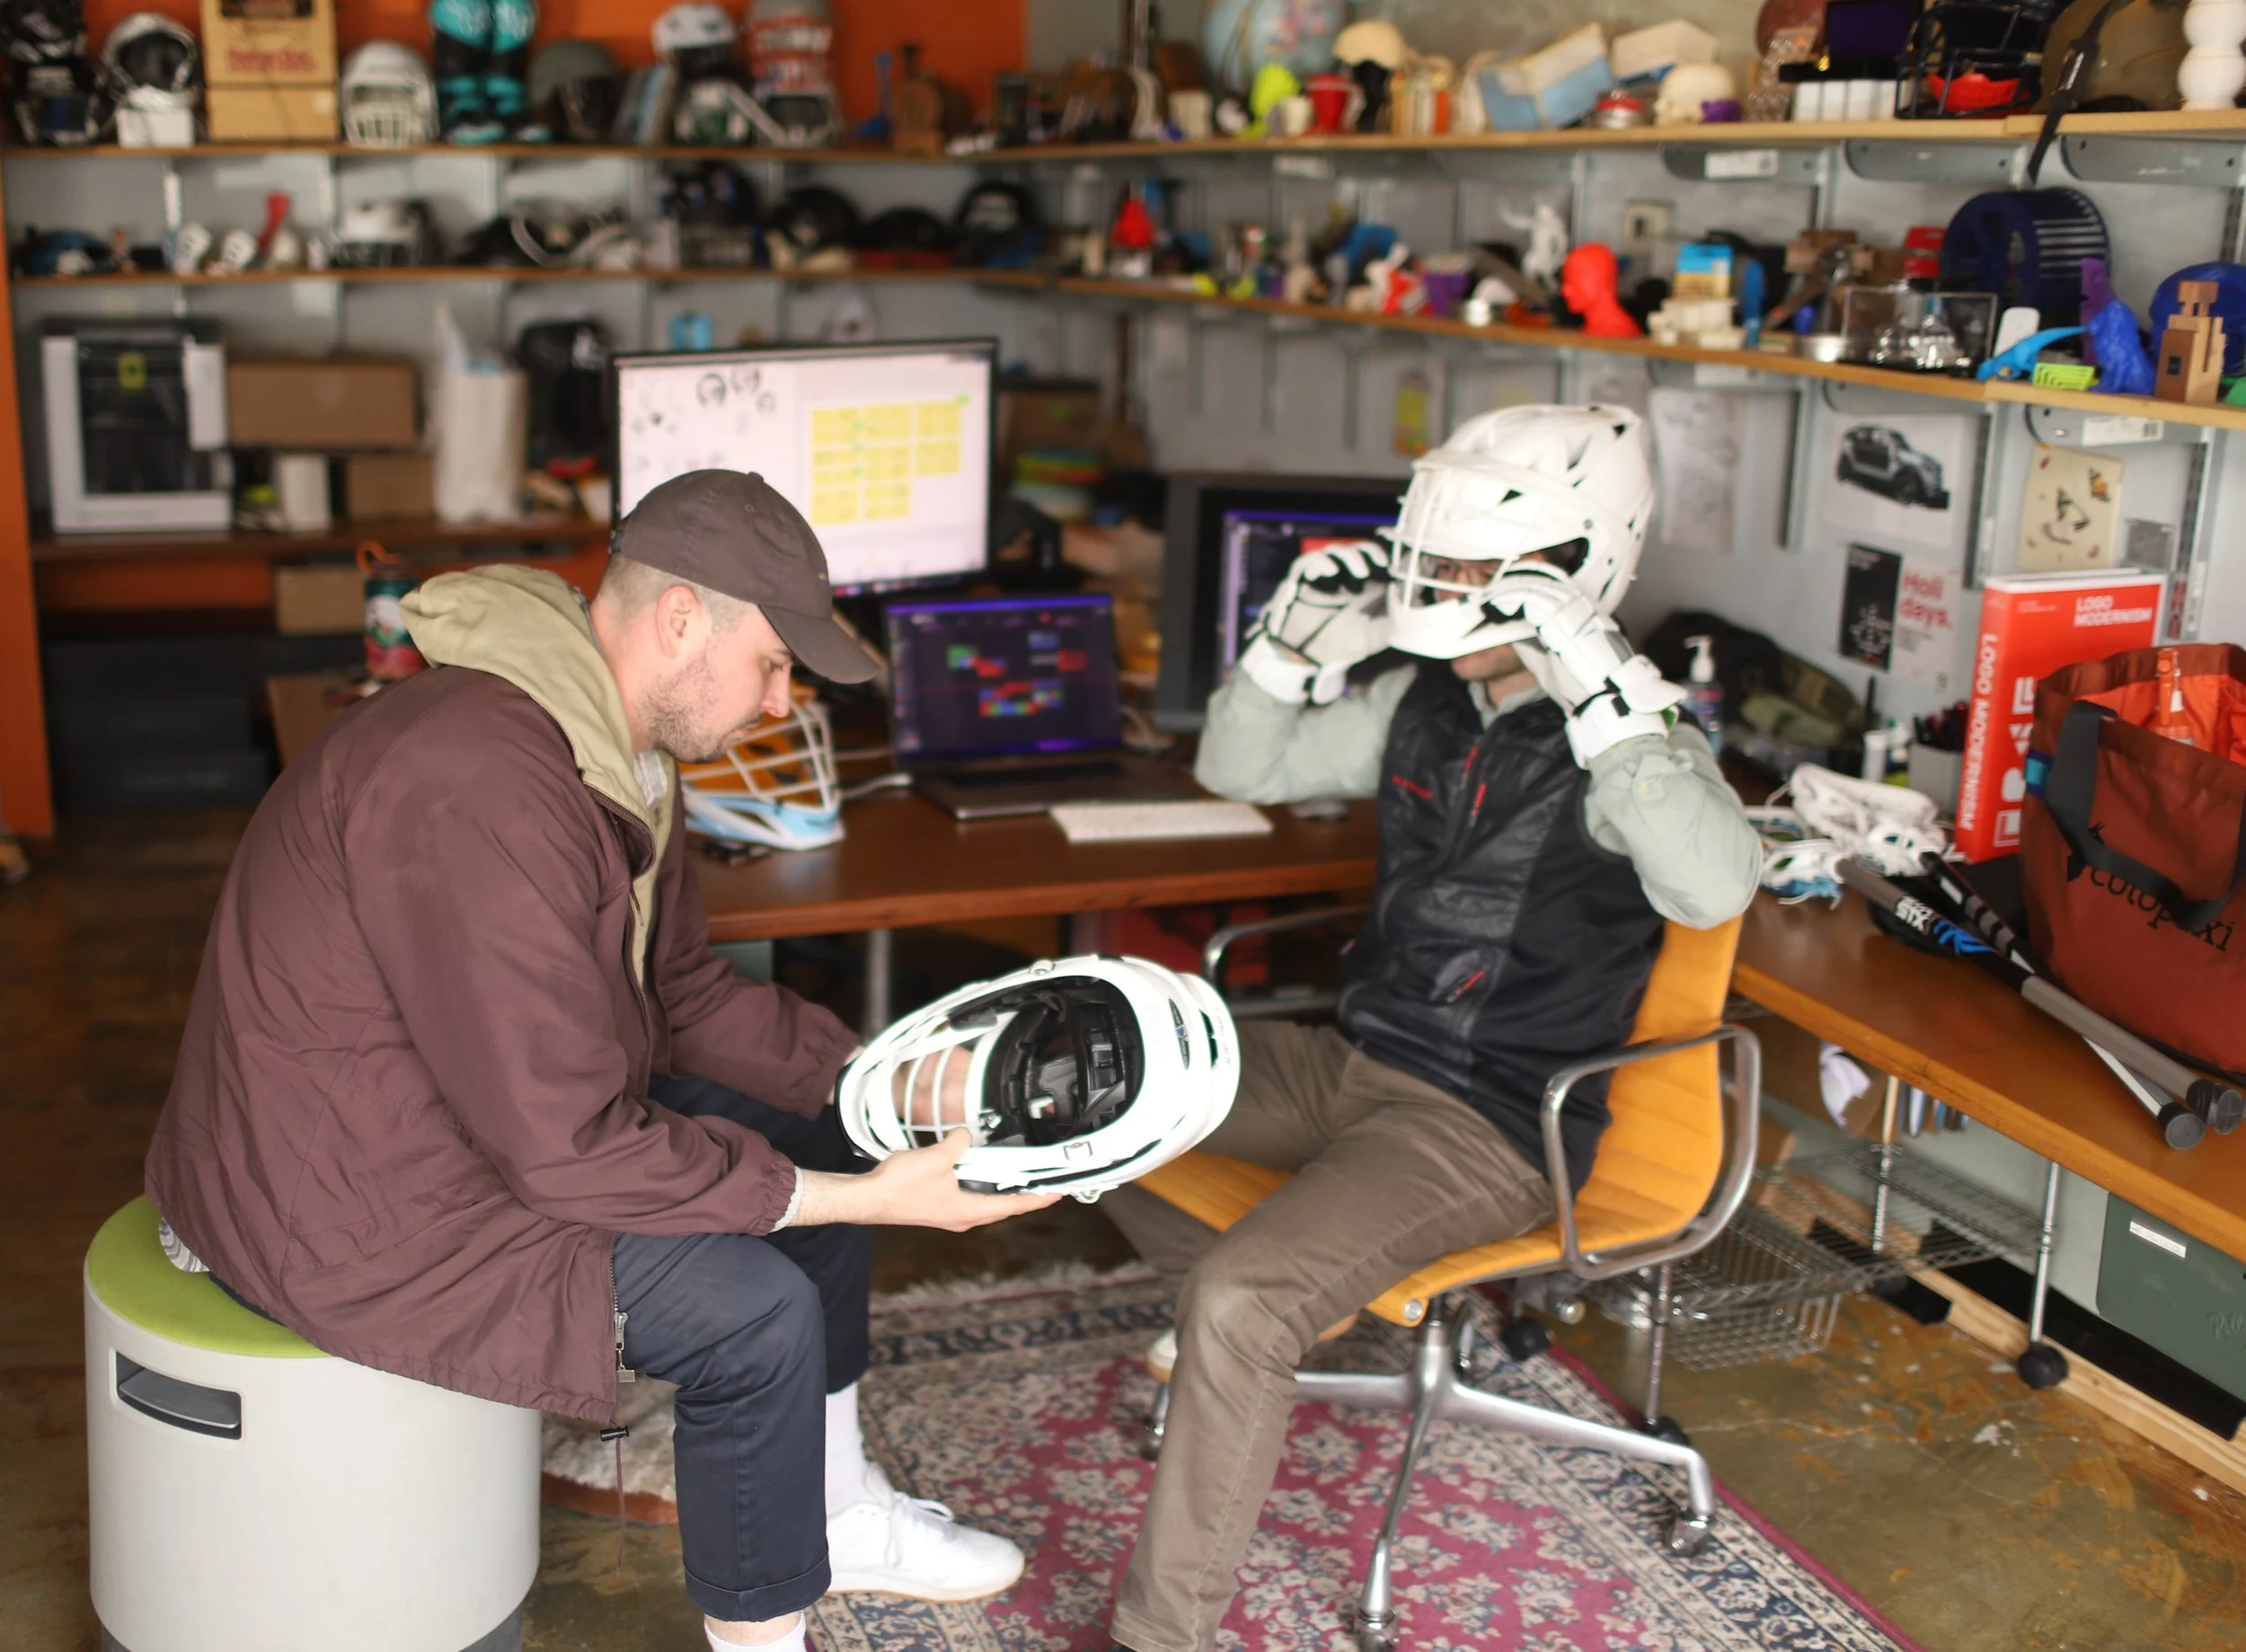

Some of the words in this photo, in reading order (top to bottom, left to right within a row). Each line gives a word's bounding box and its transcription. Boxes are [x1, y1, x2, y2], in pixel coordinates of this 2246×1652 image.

[2074, 607, 2153, 627] MODERNISM
[2076, 595, 2114, 613] LOGO
[1976, 633, 1997, 695] LOGO
[1959, 698, 1991, 831] MODERNISM
[1895, 899, 1931, 932] STX
